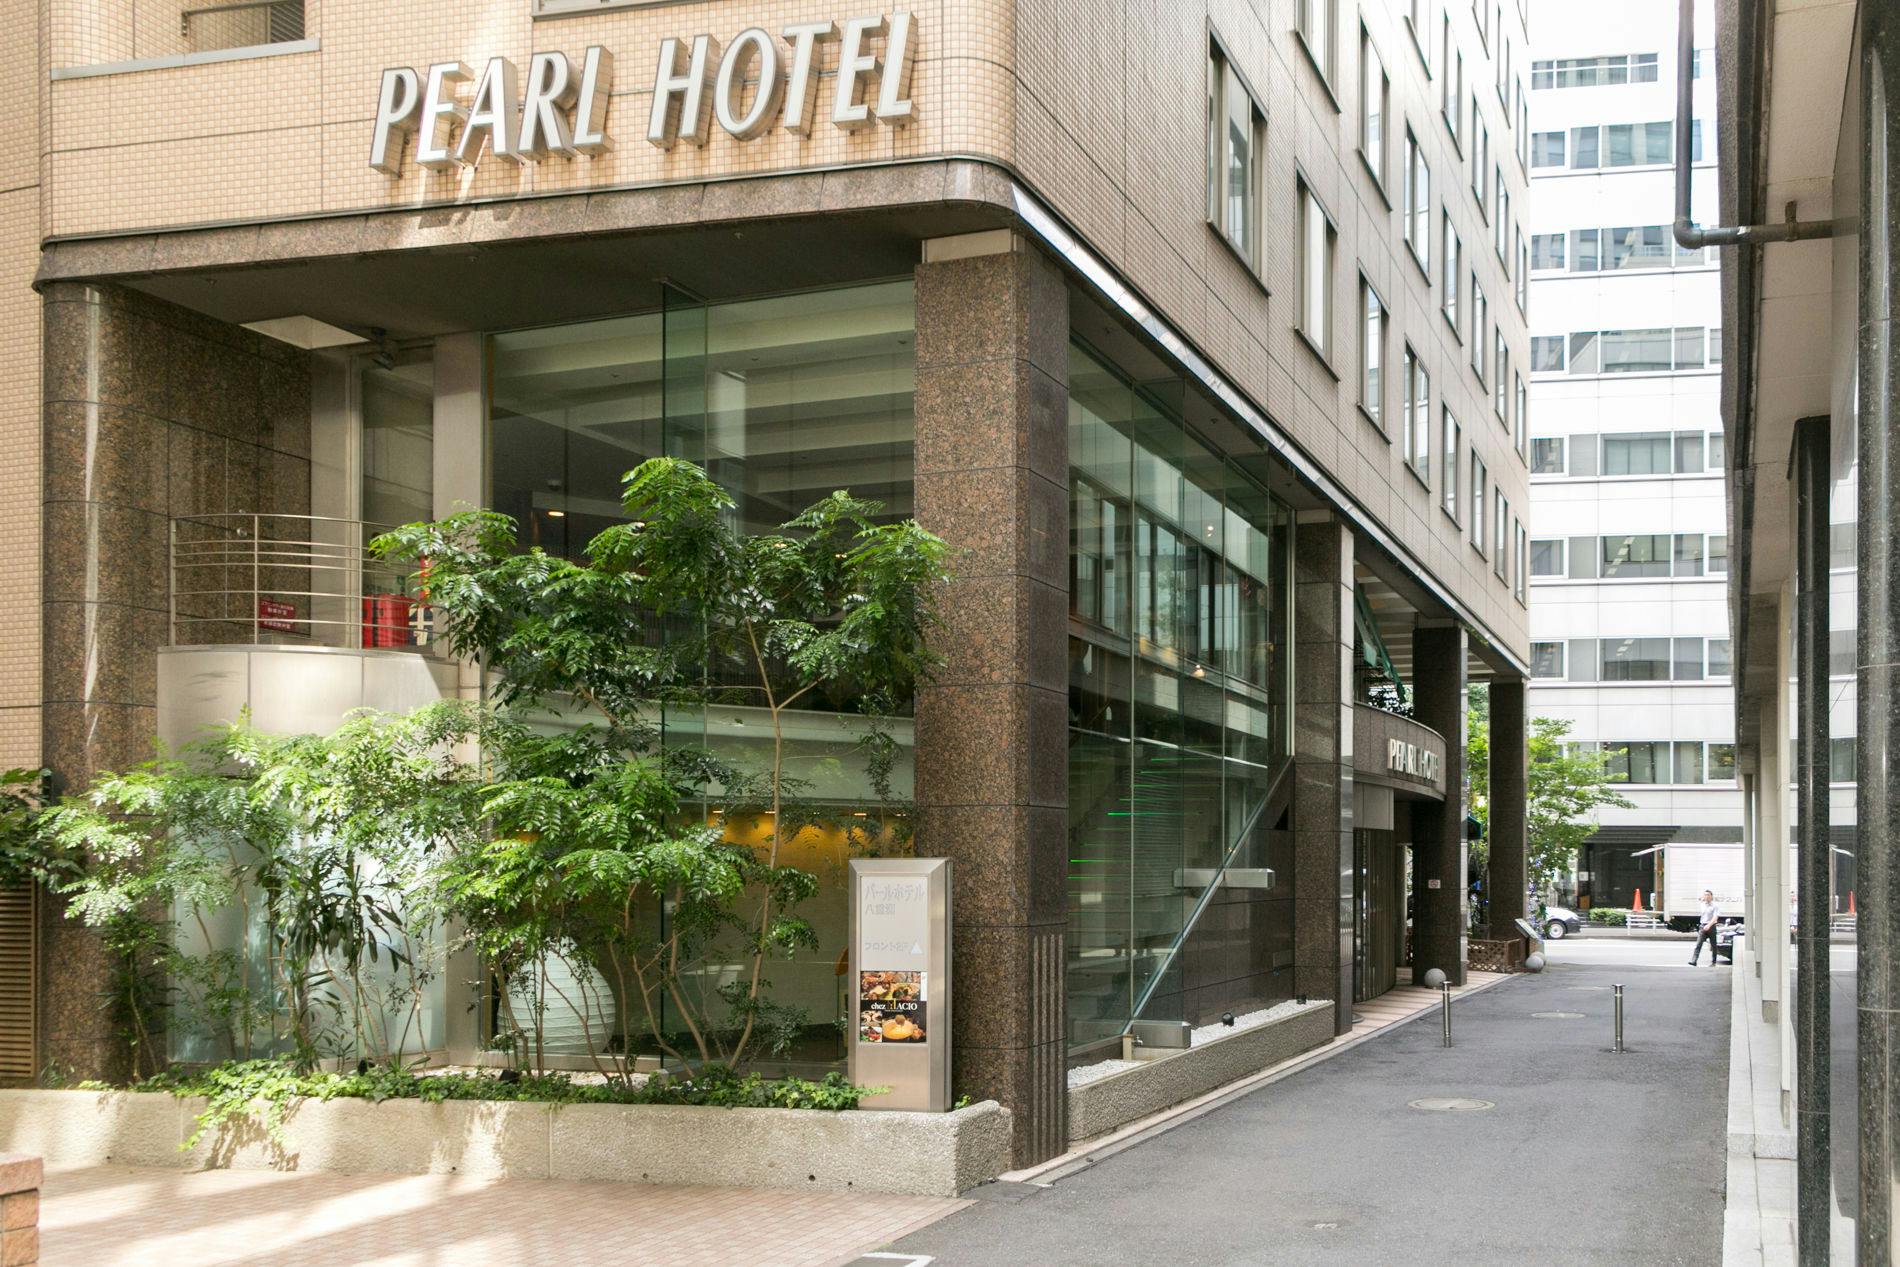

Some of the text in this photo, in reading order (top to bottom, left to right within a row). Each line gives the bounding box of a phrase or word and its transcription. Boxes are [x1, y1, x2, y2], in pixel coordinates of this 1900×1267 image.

[368, 11, 919, 175] PEARL HOTEL
[1387, 738, 1418, 775] PEARL
[871, 1002, 886, 1010] chez
